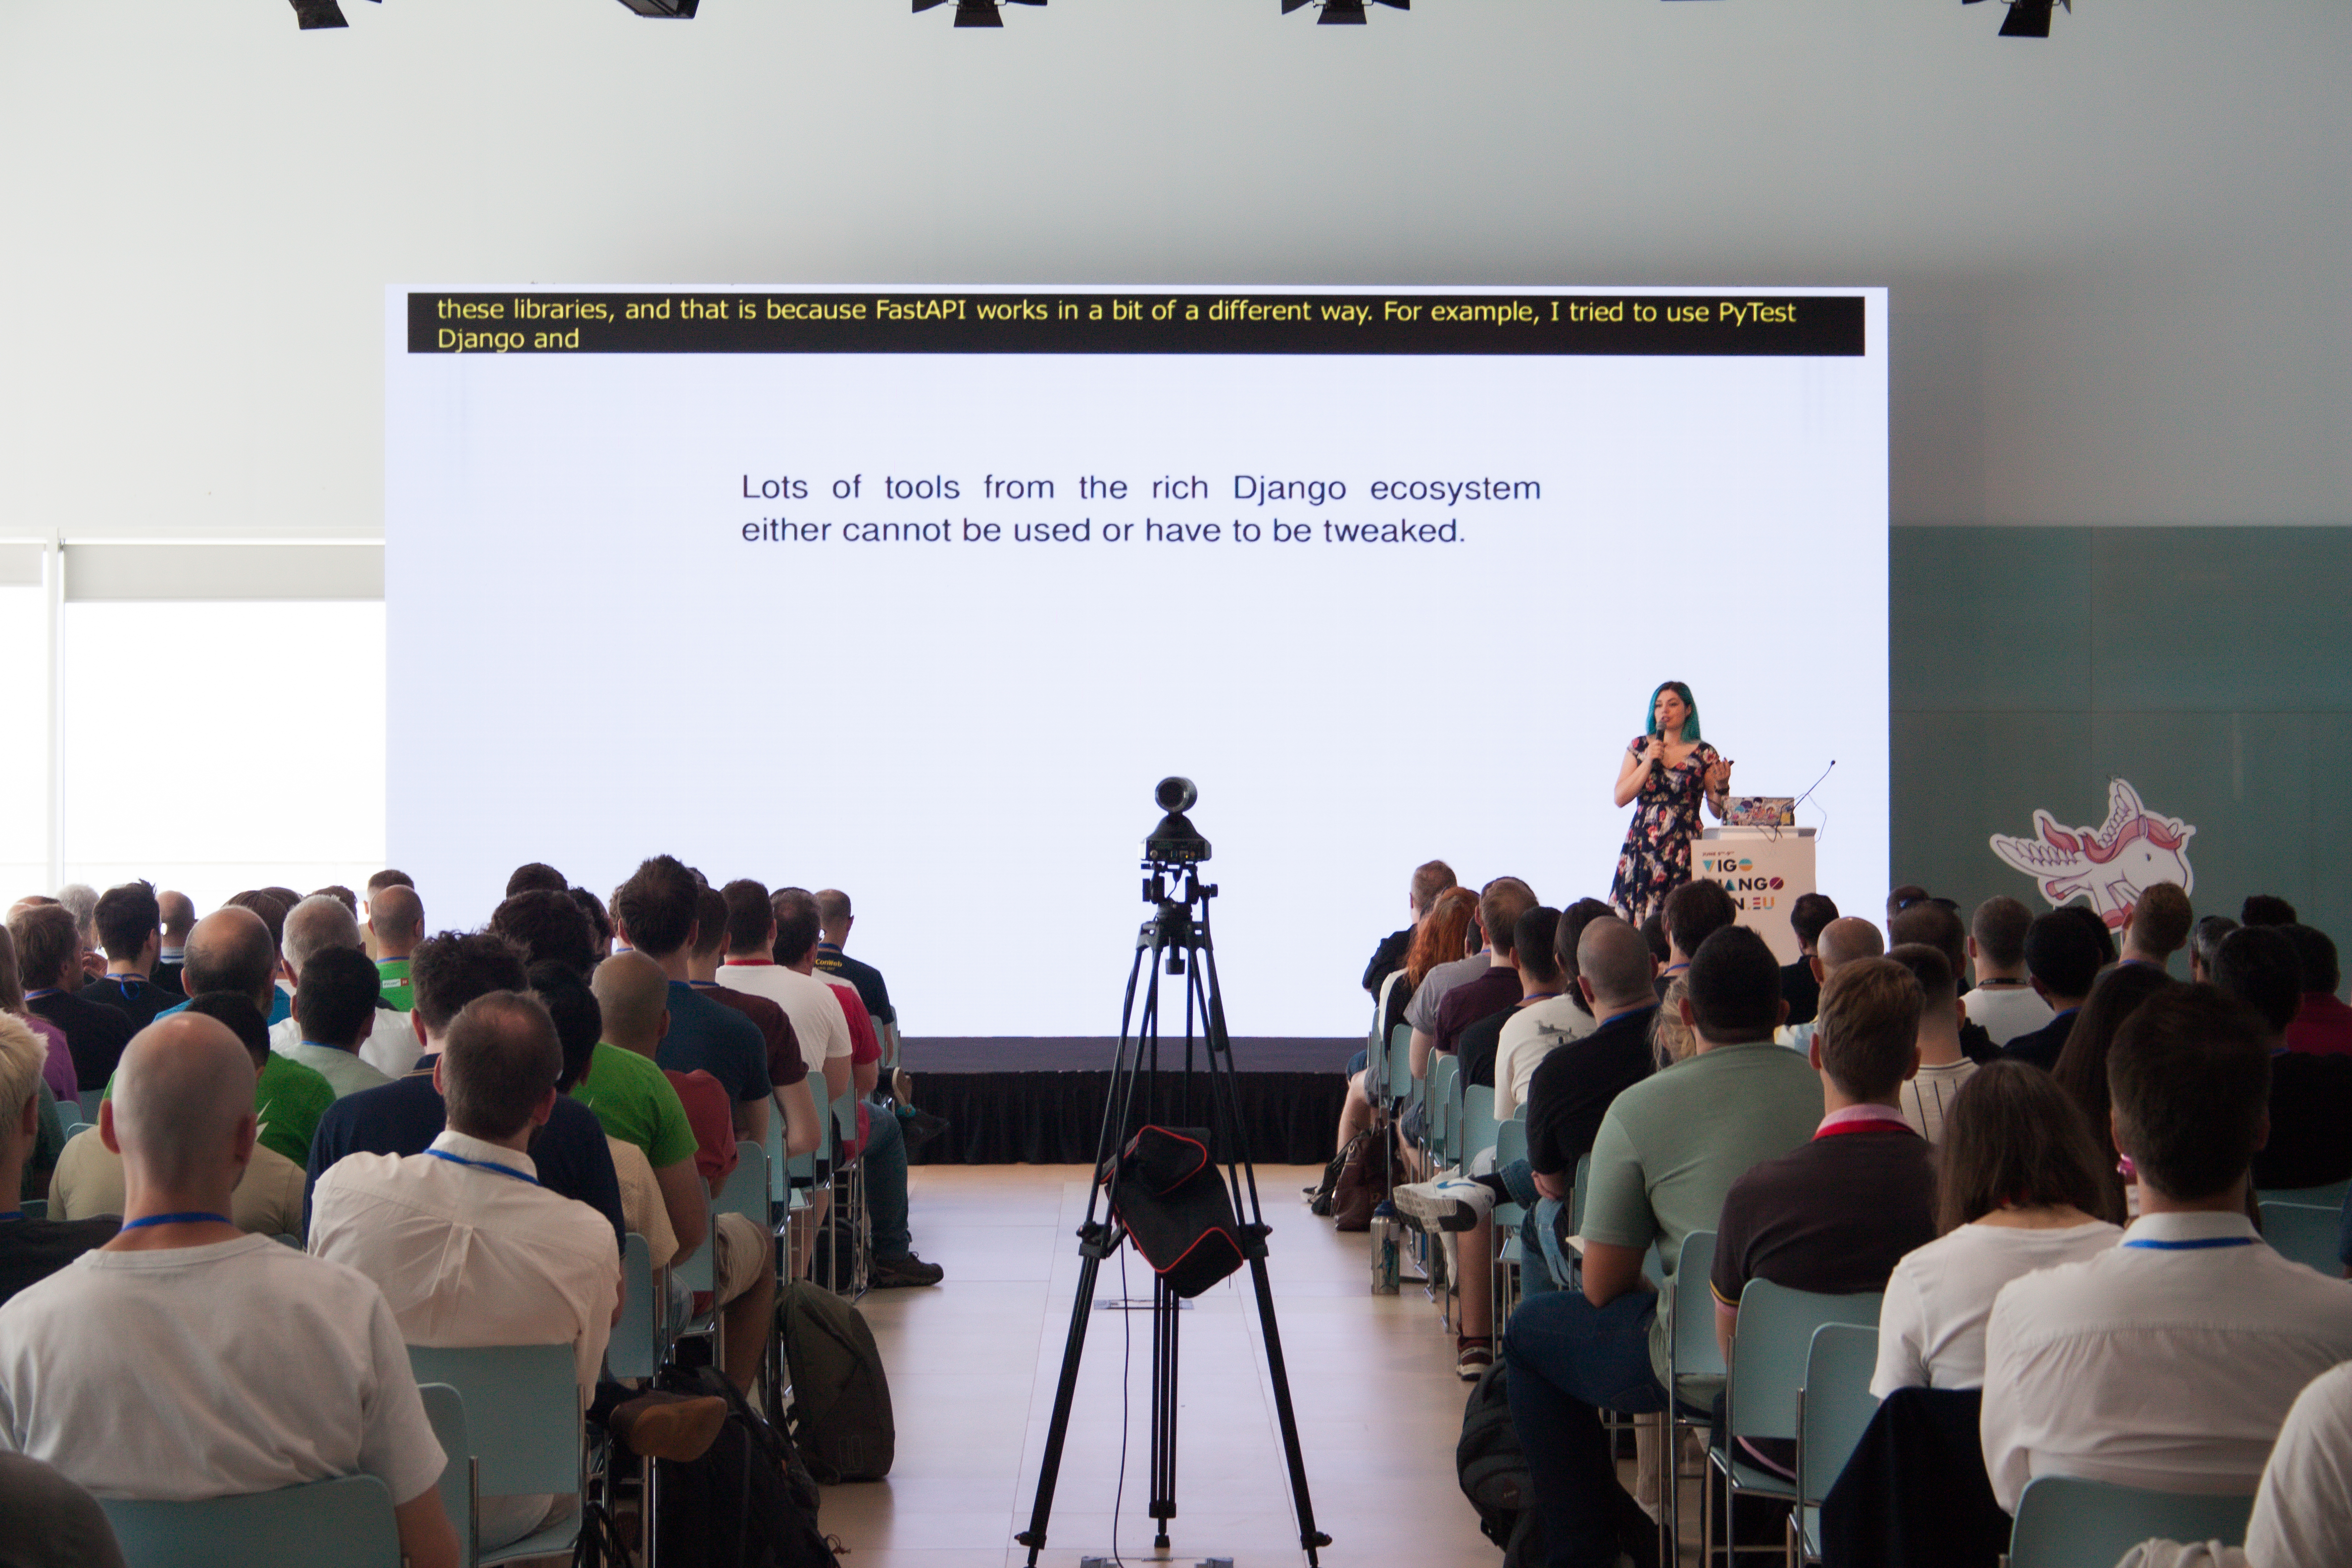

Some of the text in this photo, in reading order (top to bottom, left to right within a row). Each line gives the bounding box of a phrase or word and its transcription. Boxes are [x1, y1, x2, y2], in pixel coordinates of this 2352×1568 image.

[438, 298, 1797, 327] these libraries, and that is because FastAPI works in a bit of a different way. For example, I tried to use PyTest
[439, 327, 579, 353] Django and
[743, 474, 1540, 506] Lots of tools from the rich Django ecosystem
[742, 518, 1464, 542] either cannot be used or have to be tweaked.
[1703, 858, 1753, 872] VIGO
